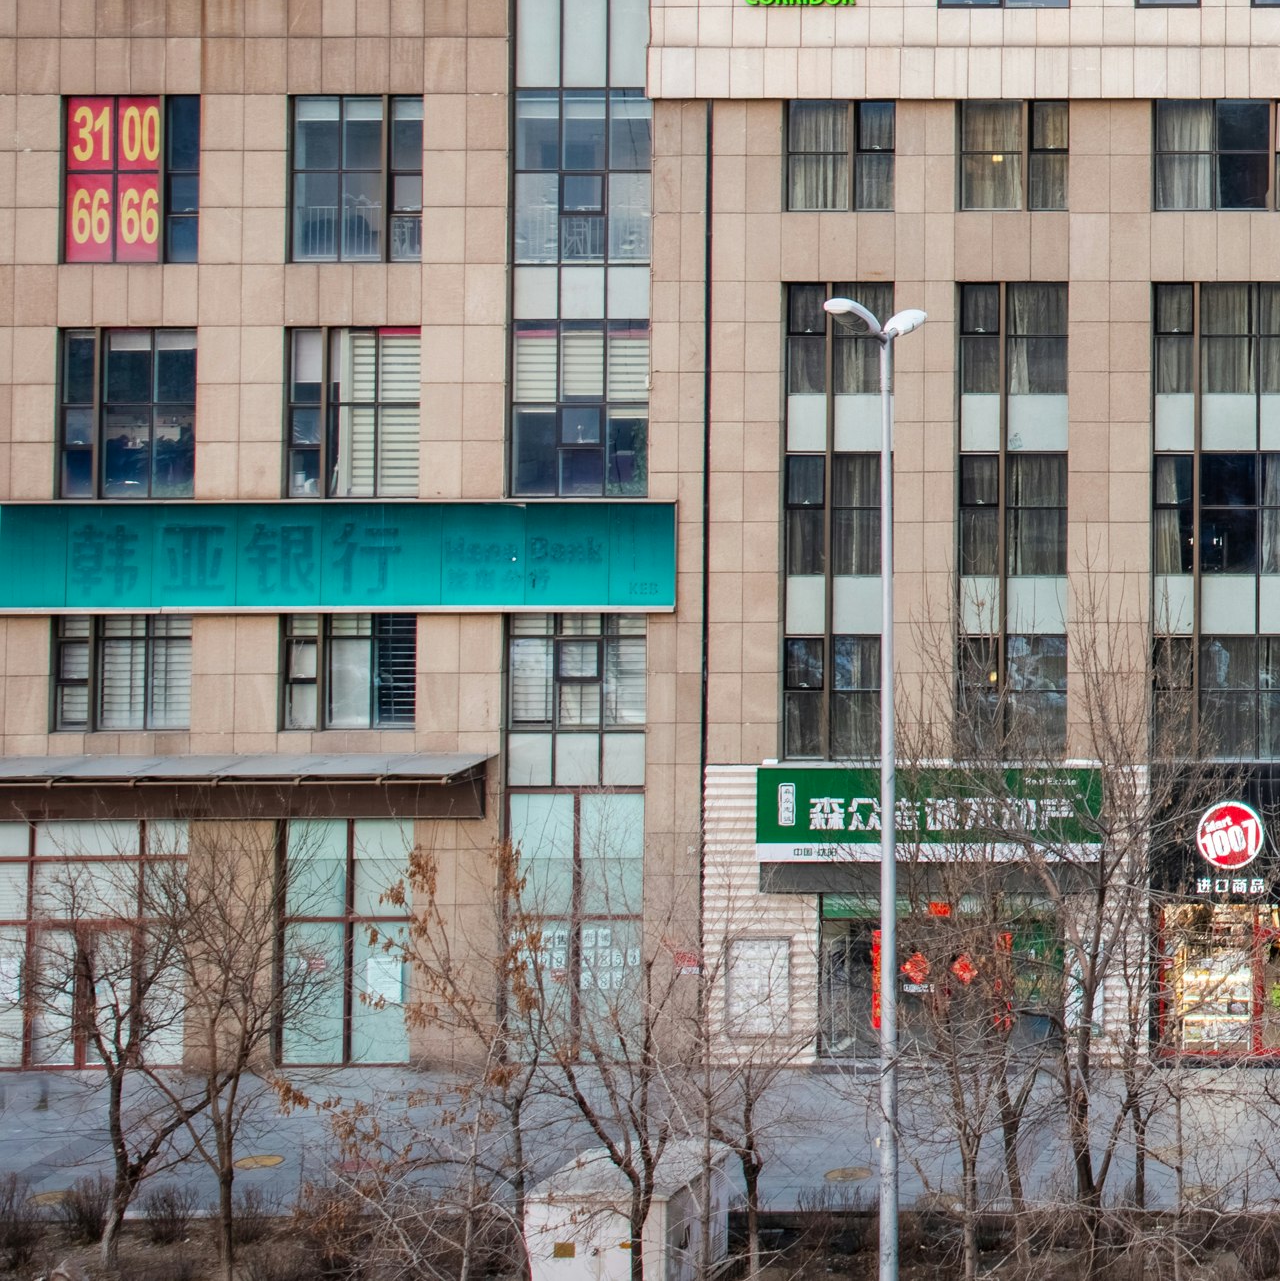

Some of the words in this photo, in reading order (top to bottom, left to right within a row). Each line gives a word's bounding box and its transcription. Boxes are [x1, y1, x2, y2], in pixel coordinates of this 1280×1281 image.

[72, 523, 402, 596] 韩亚银行
[628, 582, 659, 594] KEB
[1201, 819, 1257, 859] 1007
[793, 848, 812, 856] 中国
[1197, 879, 1265, 894] 进口商品
